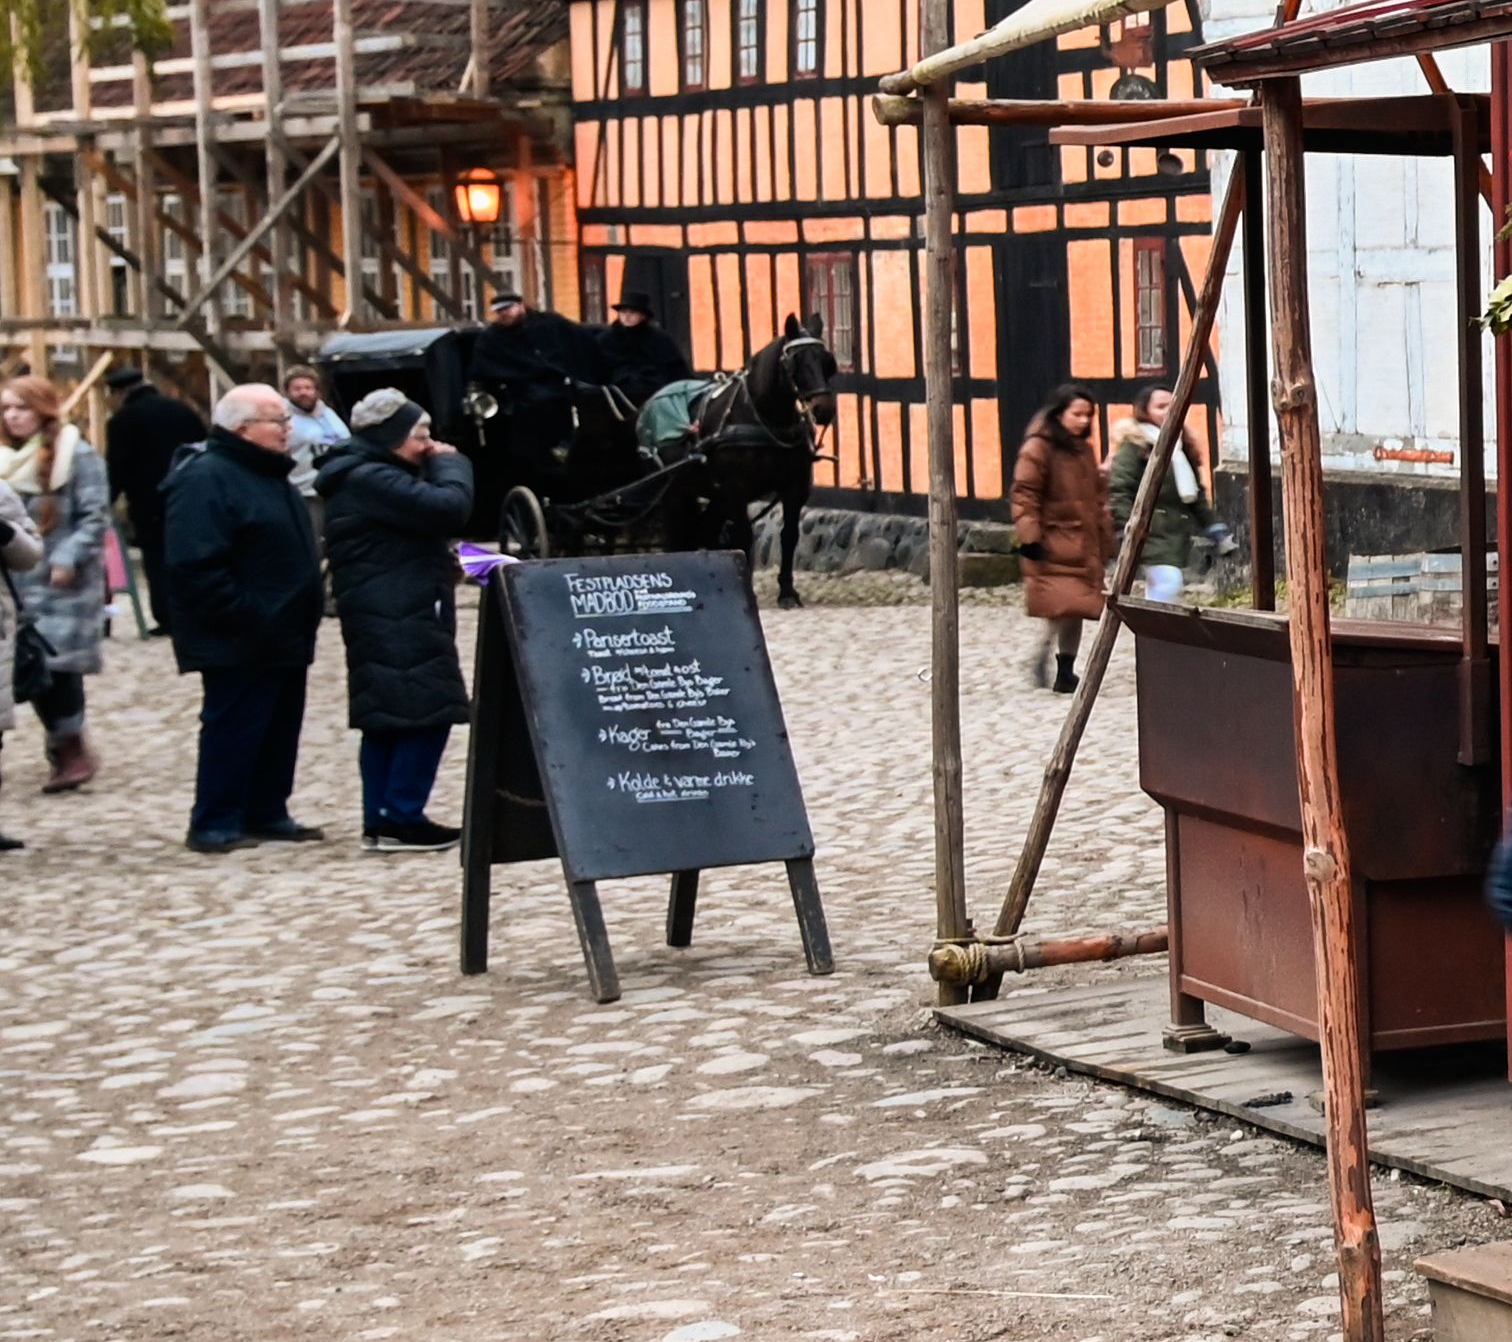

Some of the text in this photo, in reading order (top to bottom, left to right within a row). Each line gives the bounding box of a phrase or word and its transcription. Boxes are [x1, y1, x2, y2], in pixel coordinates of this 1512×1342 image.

[564, 572, 673, 593] FESTPLADSENS
[570, 589, 634, 615] MADBOD
[583, 624, 676, 648] Parisertoast
[592, 663, 633, 686] Brød
[681, 659, 701, 674] ost
[608, 723, 652, 752] Kager
[617, 770, 663, 793] Kolde
[672, 773, 713, 790] varme
[713, 770, 756, 788] drikke
